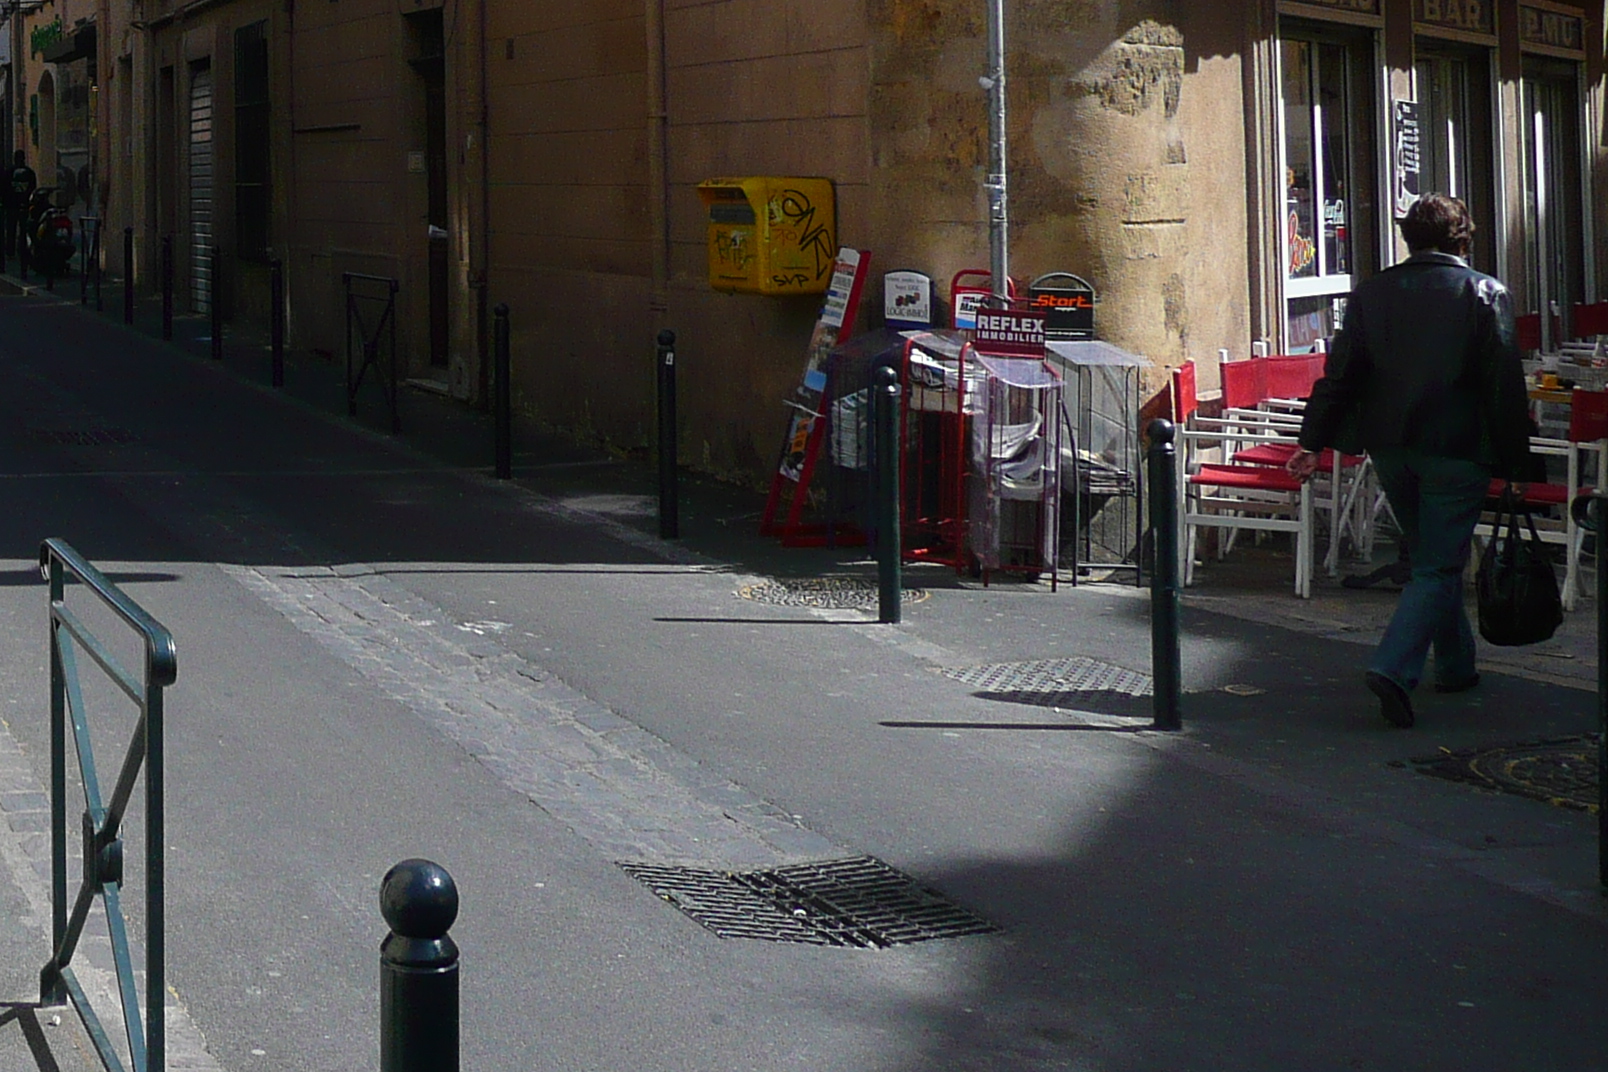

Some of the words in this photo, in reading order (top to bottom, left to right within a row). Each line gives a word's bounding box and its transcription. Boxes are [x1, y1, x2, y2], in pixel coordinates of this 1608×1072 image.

[1033, 294, 1091, 307] Start
[977, 315, 1045, 333] REFLEX
[977, 330, 1044, 343] IMMOBILIER
